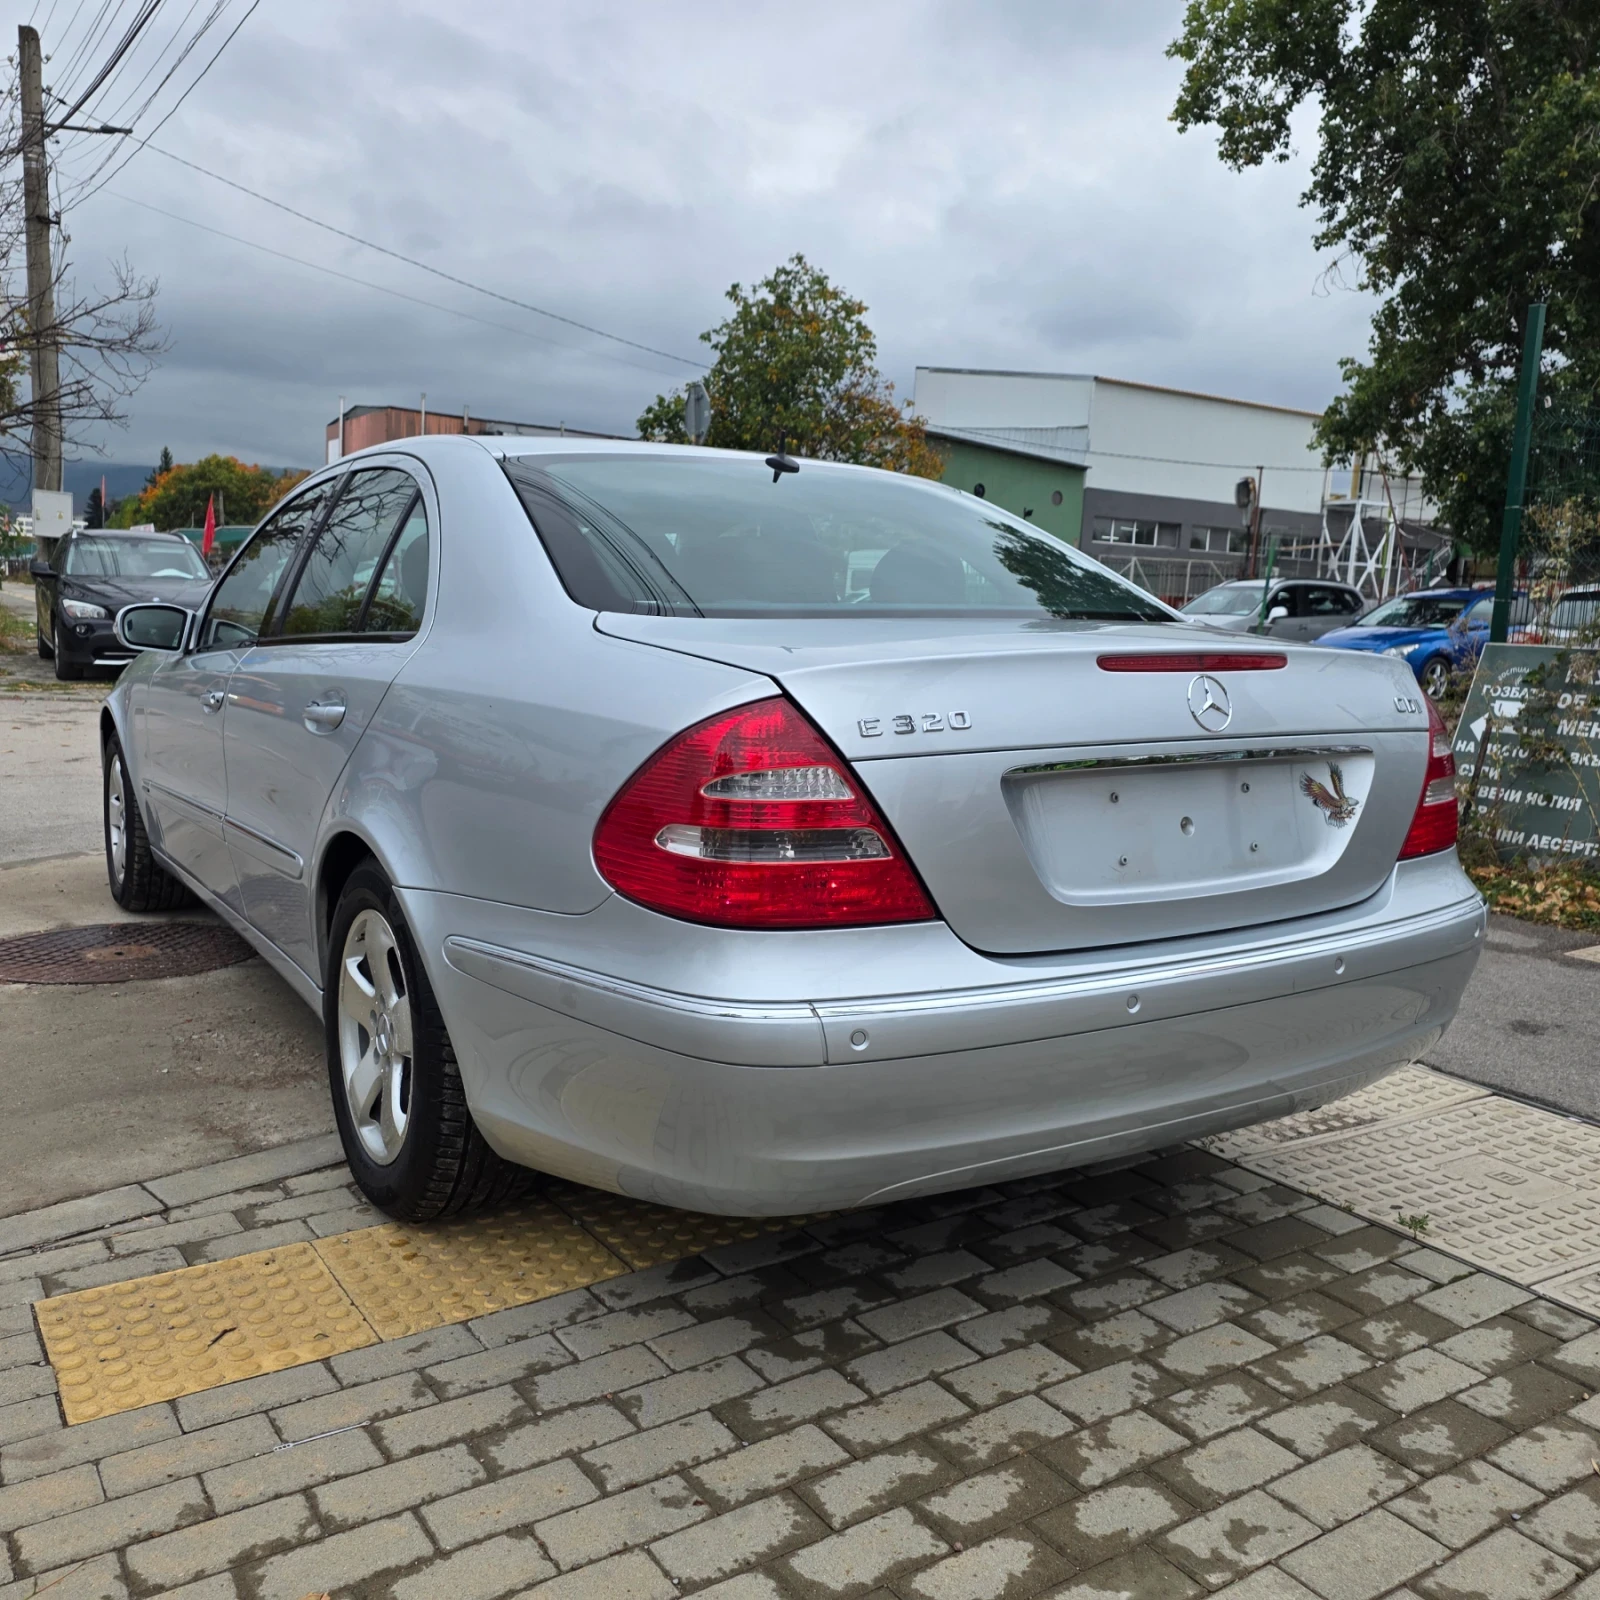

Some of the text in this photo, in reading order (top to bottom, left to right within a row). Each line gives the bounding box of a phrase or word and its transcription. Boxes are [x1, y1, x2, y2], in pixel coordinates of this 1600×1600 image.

[1393, 696, 1422, 714] CDI
[857, 710, 972, 738] E 320
[1455, 739, 1475, 753] НА
